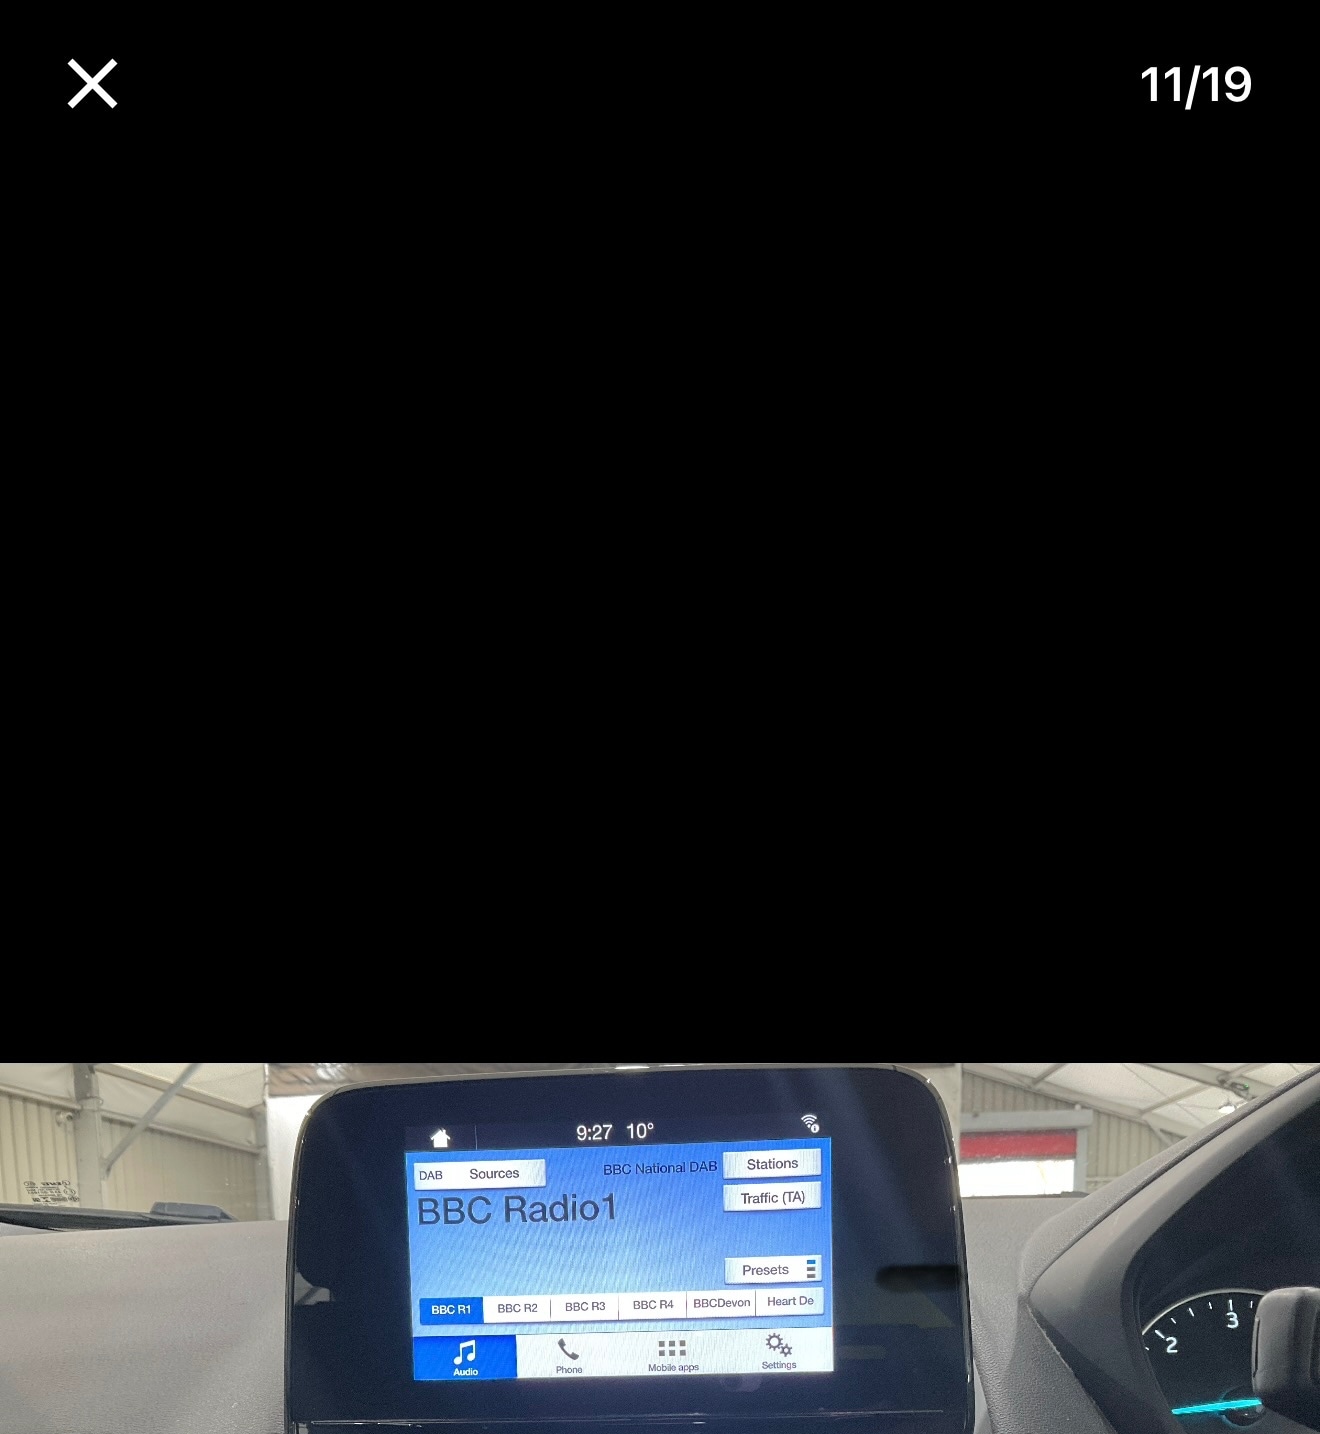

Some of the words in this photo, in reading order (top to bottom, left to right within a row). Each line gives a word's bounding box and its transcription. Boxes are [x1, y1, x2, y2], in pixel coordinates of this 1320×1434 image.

[577, 1124, 612, 1141] 9:27
[627, 1123, 655, 1139] 10°
[603, 1164, 631, 1175] BBC
[635, 1162, 686, 1174] National
[690, 1161, 717, 1173] DAB
[747, 1158, 798, 1171] Stations
[419, 1169, 443, 1181] DAB
[469, 1167, 519, 1180] Sources
[741, 1192, 779, 1205] Traffic
[782, 1191, 805, 1205] (TA)
[418, 1196, 492, 1225] BBC
[504, 1193, 616, 1223] Radio1
[742, 1264, 789, 1276] Presets
[565, 1302, 588, 1312] BBC
[591, 1301, 606, 1311] R3
[633, 1300, 656, 1310] BBC
[659, 1299, 674, 1309] R4
[694, 1297, 750, 1308] BBCDevon
[767, 1296, 796, 1307] Heart
[798, 1295, 814, 1305] De
[431, 1304, 455, 1315] BBC
[457, 1303, 471, 1315] R1
[498, 1303, 520, 1313] BBC
[523, 1303, 538, 1313] R2
[1226, 1312, 1239, 1329] 3
[1166, 1337, 1178, 1353] 2
[556, 1365, 583, 1374] Phone
[648, 1363, 676, 1373] Mobile
[679, 1364, 699, 1373] apps
[762, 1360, 796, 1370] Settings
[454, 1367, 478, 1377] Audio
